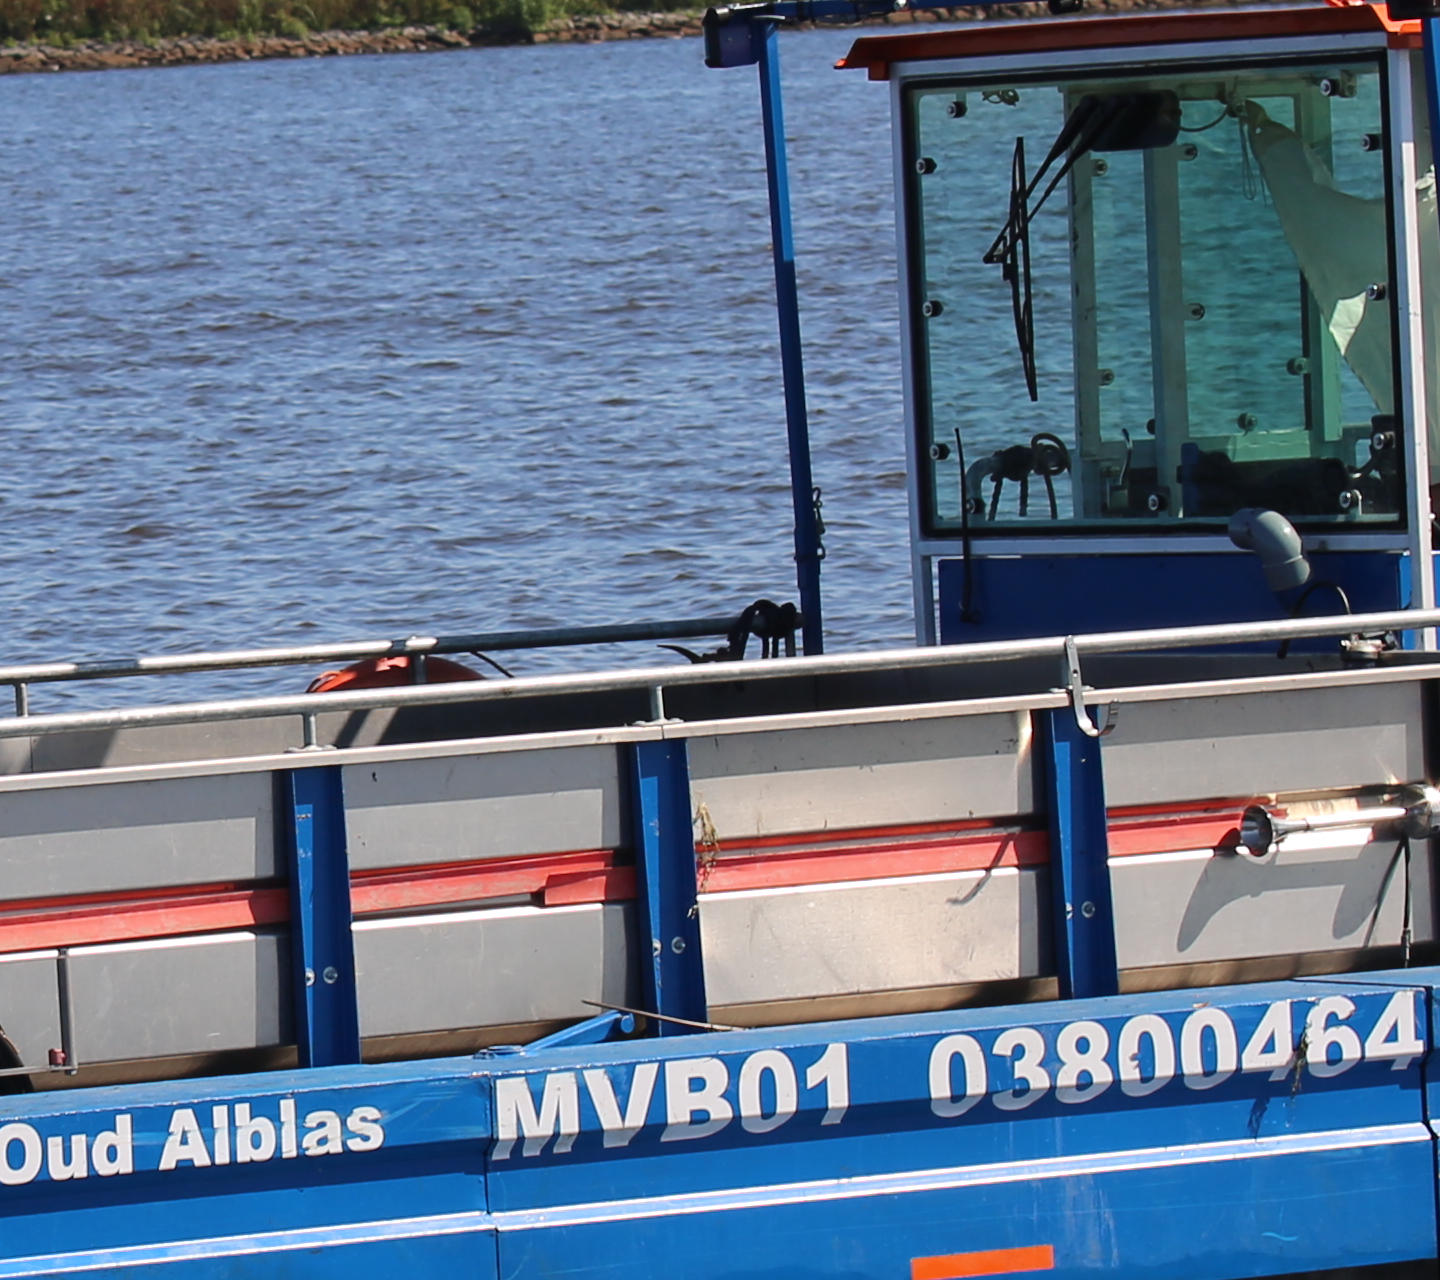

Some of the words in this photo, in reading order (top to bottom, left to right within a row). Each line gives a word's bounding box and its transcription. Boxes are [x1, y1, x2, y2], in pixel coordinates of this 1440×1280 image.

[158, 1098, 386, 1172] Alblas
[491, 1042, 850, 1161] MVB01
[928, 989, 1425, 1118] 03800464
